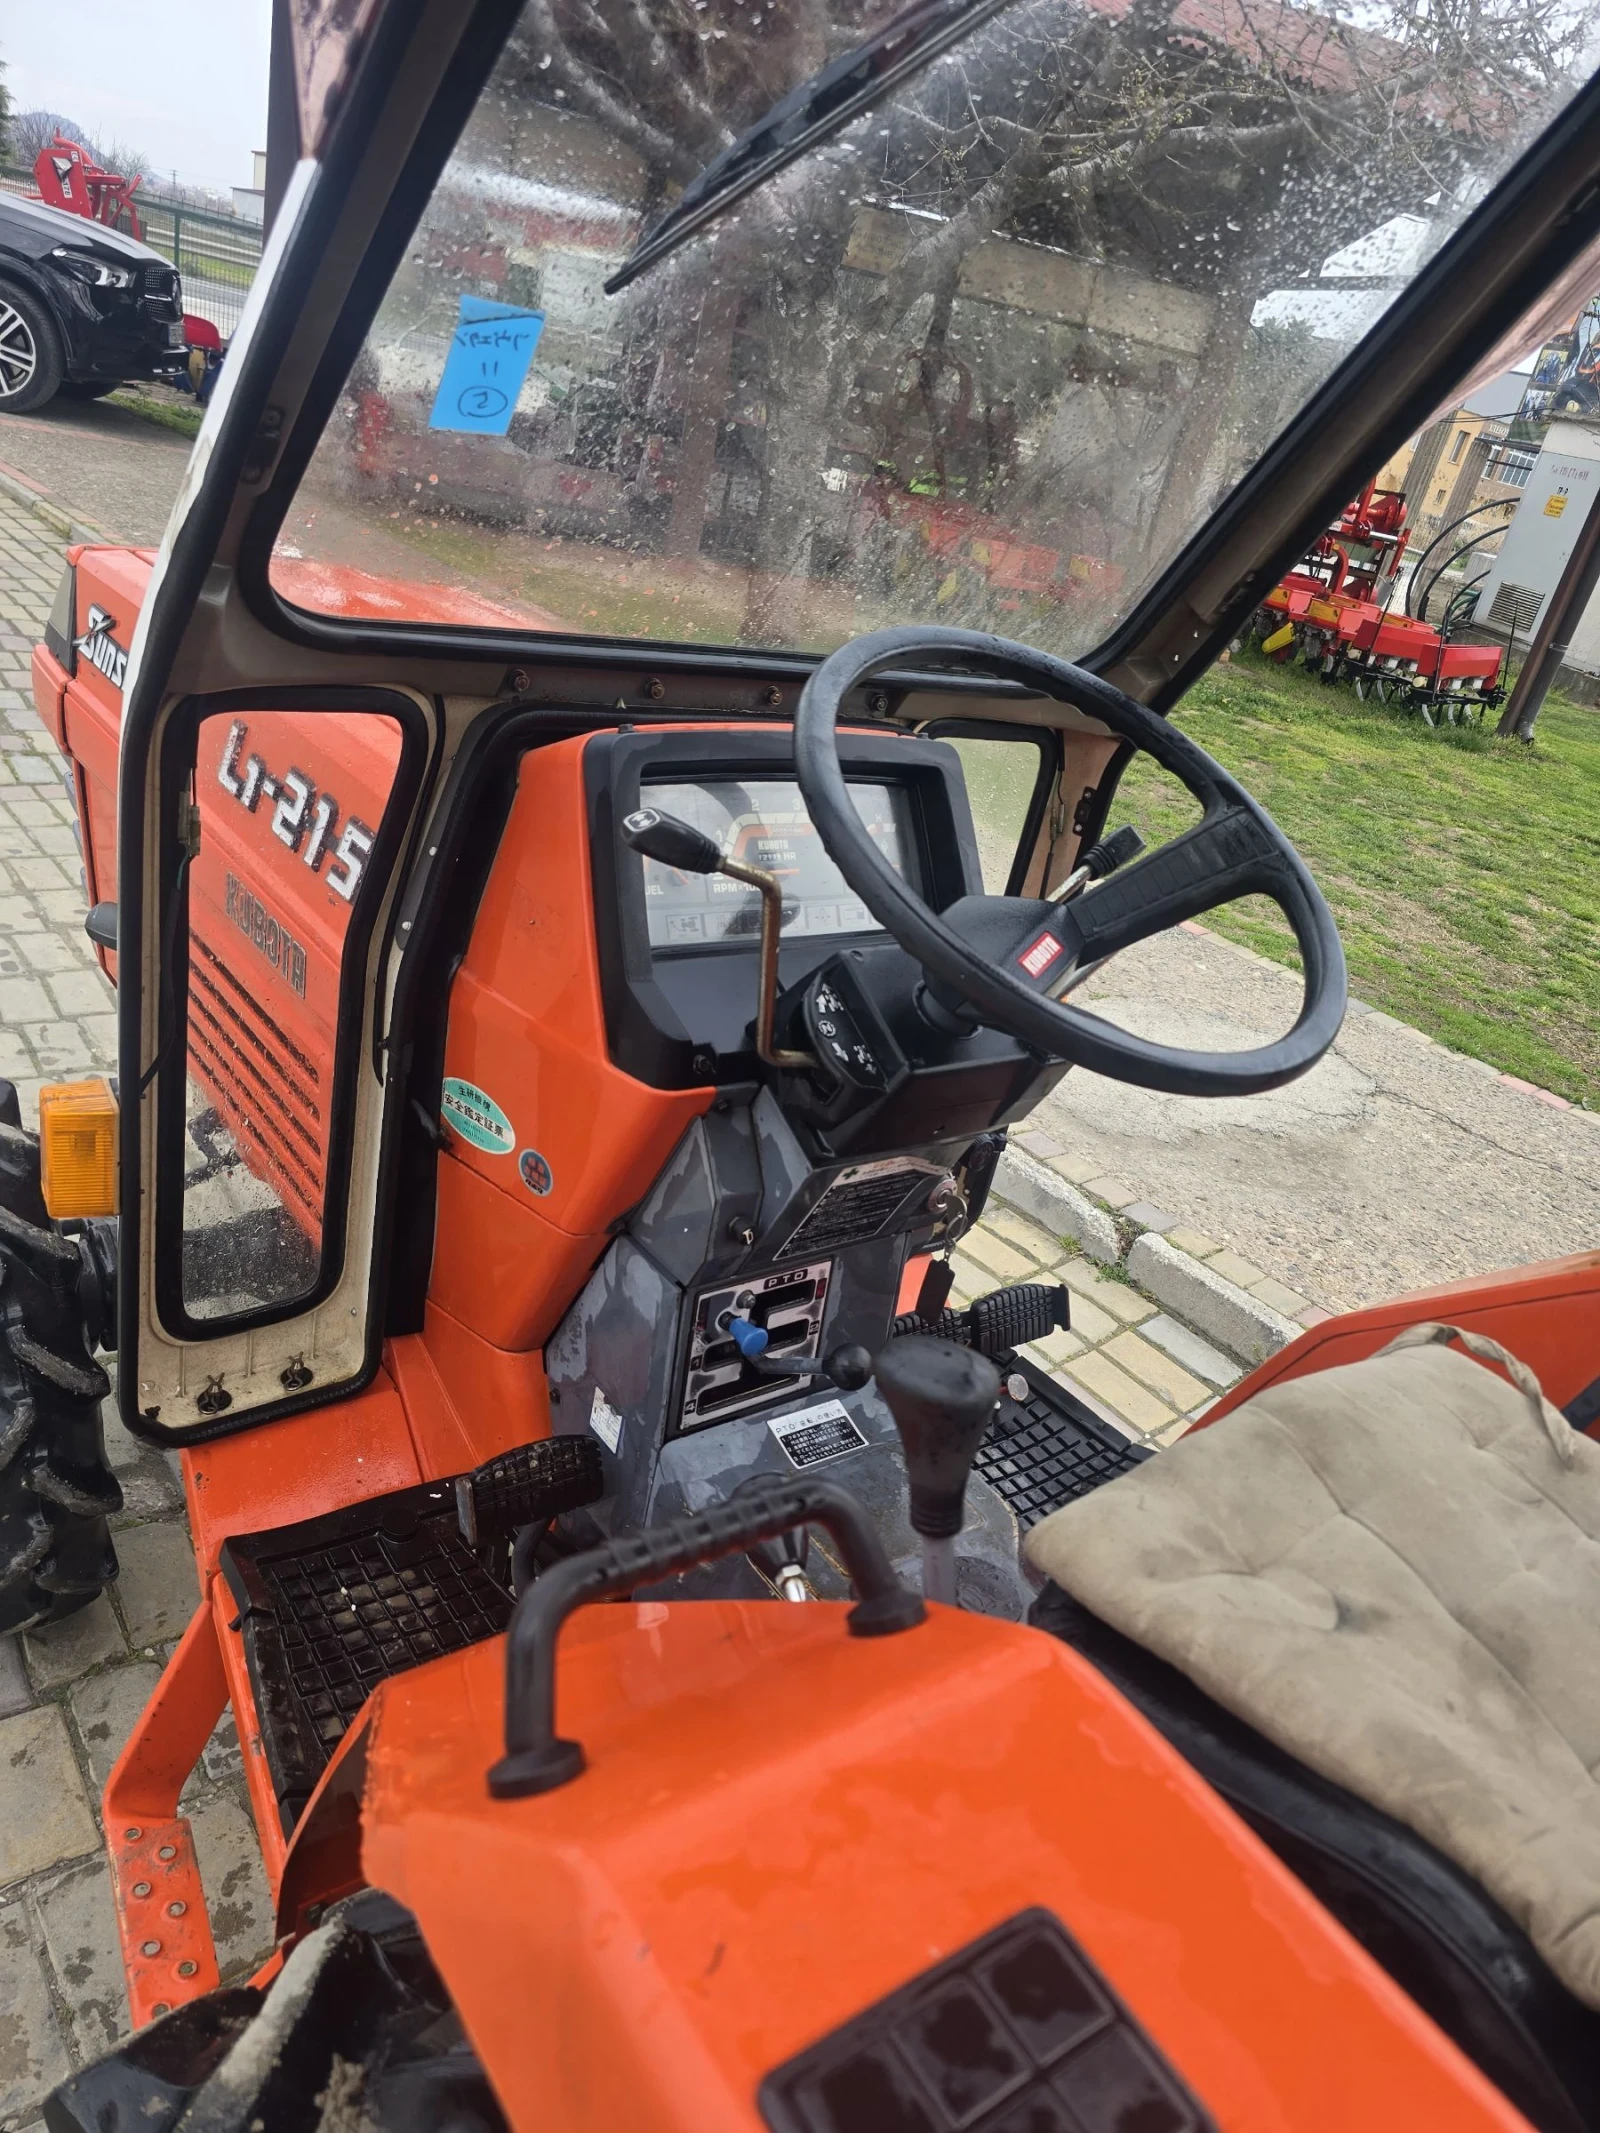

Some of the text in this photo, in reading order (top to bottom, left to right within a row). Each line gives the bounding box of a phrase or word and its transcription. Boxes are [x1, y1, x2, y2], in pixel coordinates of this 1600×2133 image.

[751, 799, 760, 811] 2
[758, 840, 789, 851] KUBOTA
[783, 851, 797, 861] HR
[1022, 936, 1061, 975] KUBOTA
[768, 1271, 804, 1288] PTO
